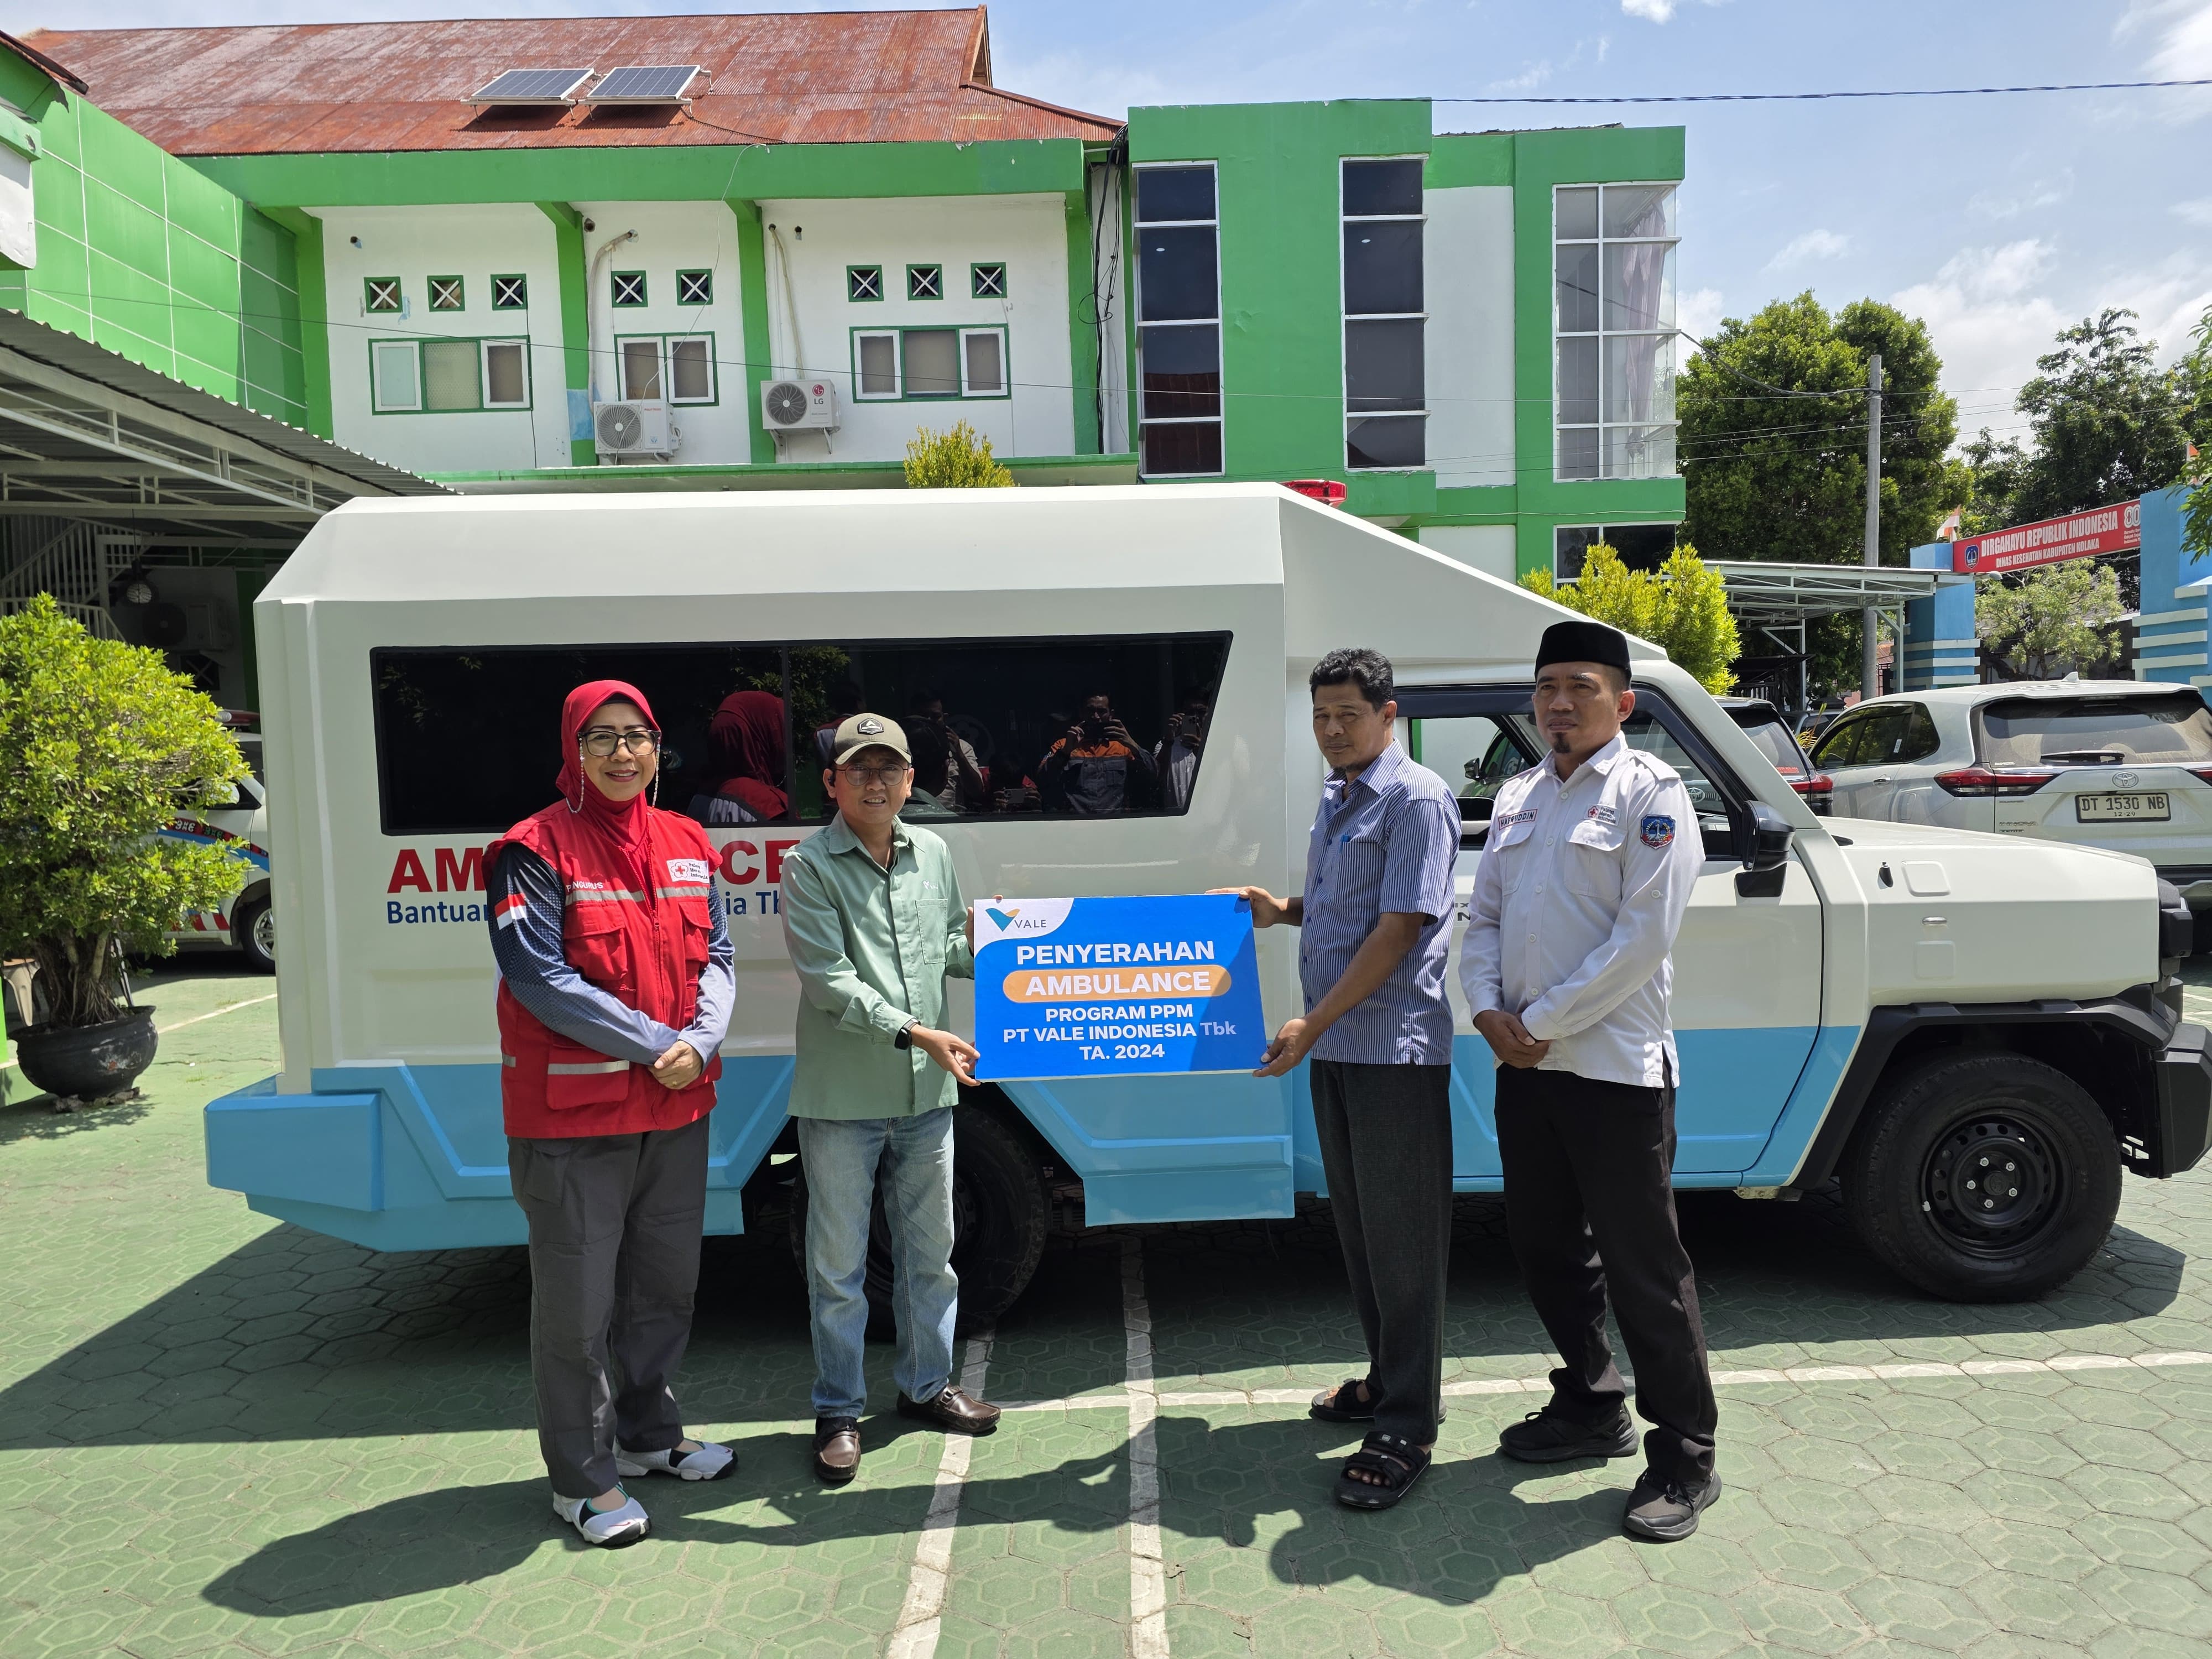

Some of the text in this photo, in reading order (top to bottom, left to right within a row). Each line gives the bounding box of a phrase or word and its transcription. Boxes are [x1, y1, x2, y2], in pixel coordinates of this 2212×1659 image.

[1981, 531, 2026, 557] DIRGAHAYU
[2027, 521, 2068, 548] REPUBLIK
[2069, 510, 2118, 539] INDONESIA
[1996, 538, 2100, 568] DINAS KESEHATAN KABUPATEN KOLAKA
[2081, 796, 2165, 811] DT 1530 NB
[566, 880, 604, 893] PNGURUS
[725, 891, 747, 915] ia
[1014, 919, 1047, 928] VALE
[1016, 941, 1215, 965] PENYERAHAN
[1025, 971, 1211, 996] AMBULANCE
[1045, 1004, 1193, 1022] PROGRAM PPM
[1003, 1021, 1237, 1043] PT VALE INDONESIA Tbk
[1079, 1044, 1165, 1060] TA. 2024
